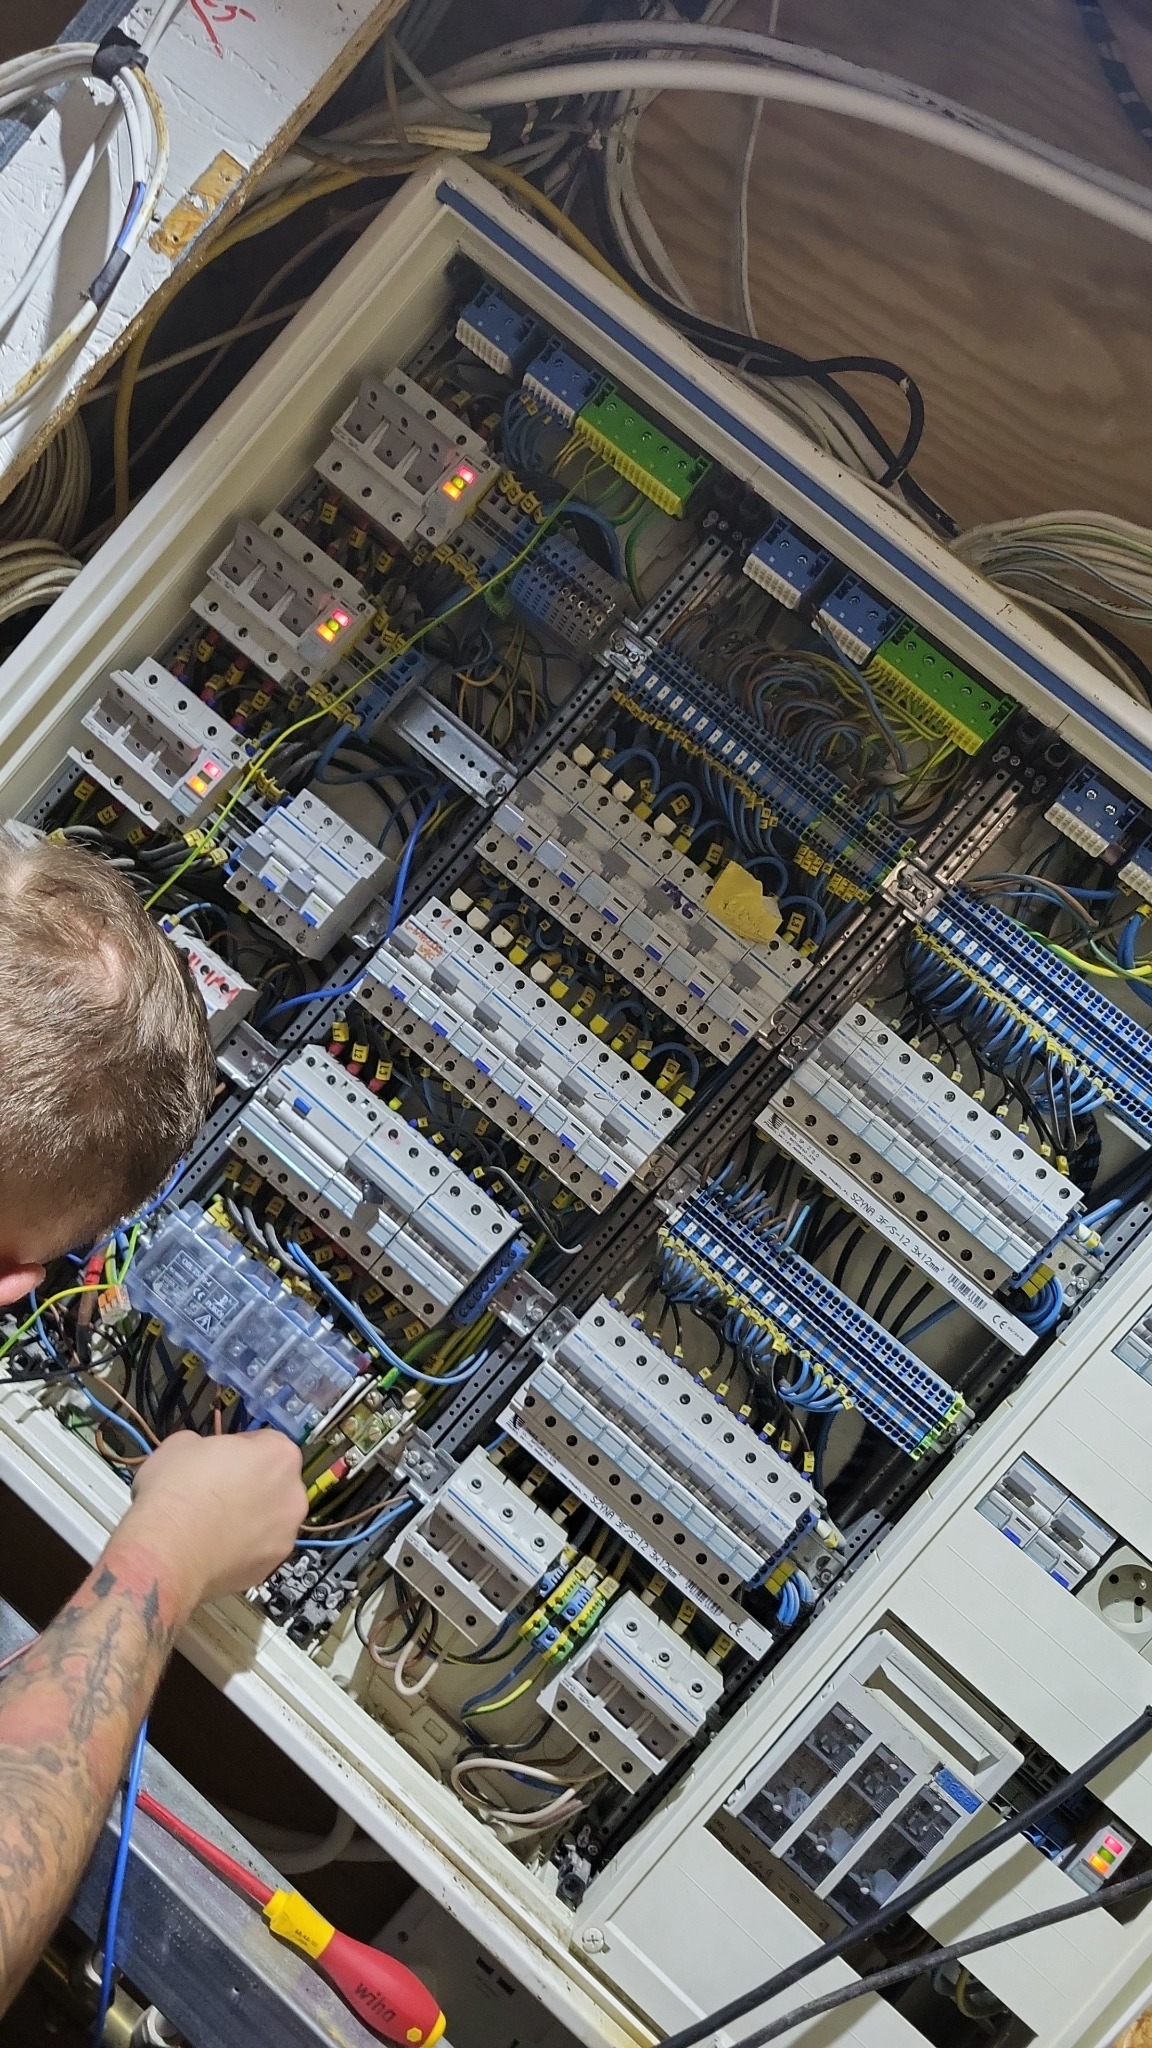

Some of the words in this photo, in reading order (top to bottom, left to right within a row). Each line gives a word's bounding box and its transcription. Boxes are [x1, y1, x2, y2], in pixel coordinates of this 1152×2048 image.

[848, 1191, 876, 1216] SZYNA
[874, 1214, 911, 1246] 3F/S-12
[588, 1494, 616, 1520] SZYNA
[612, 1517, 651, 1552] 3F/S-12
[581, 1560, 593, 1572] PE
[604, 1579, 616, 1591] PE
[354, 1982, 396, 2024] wiha
